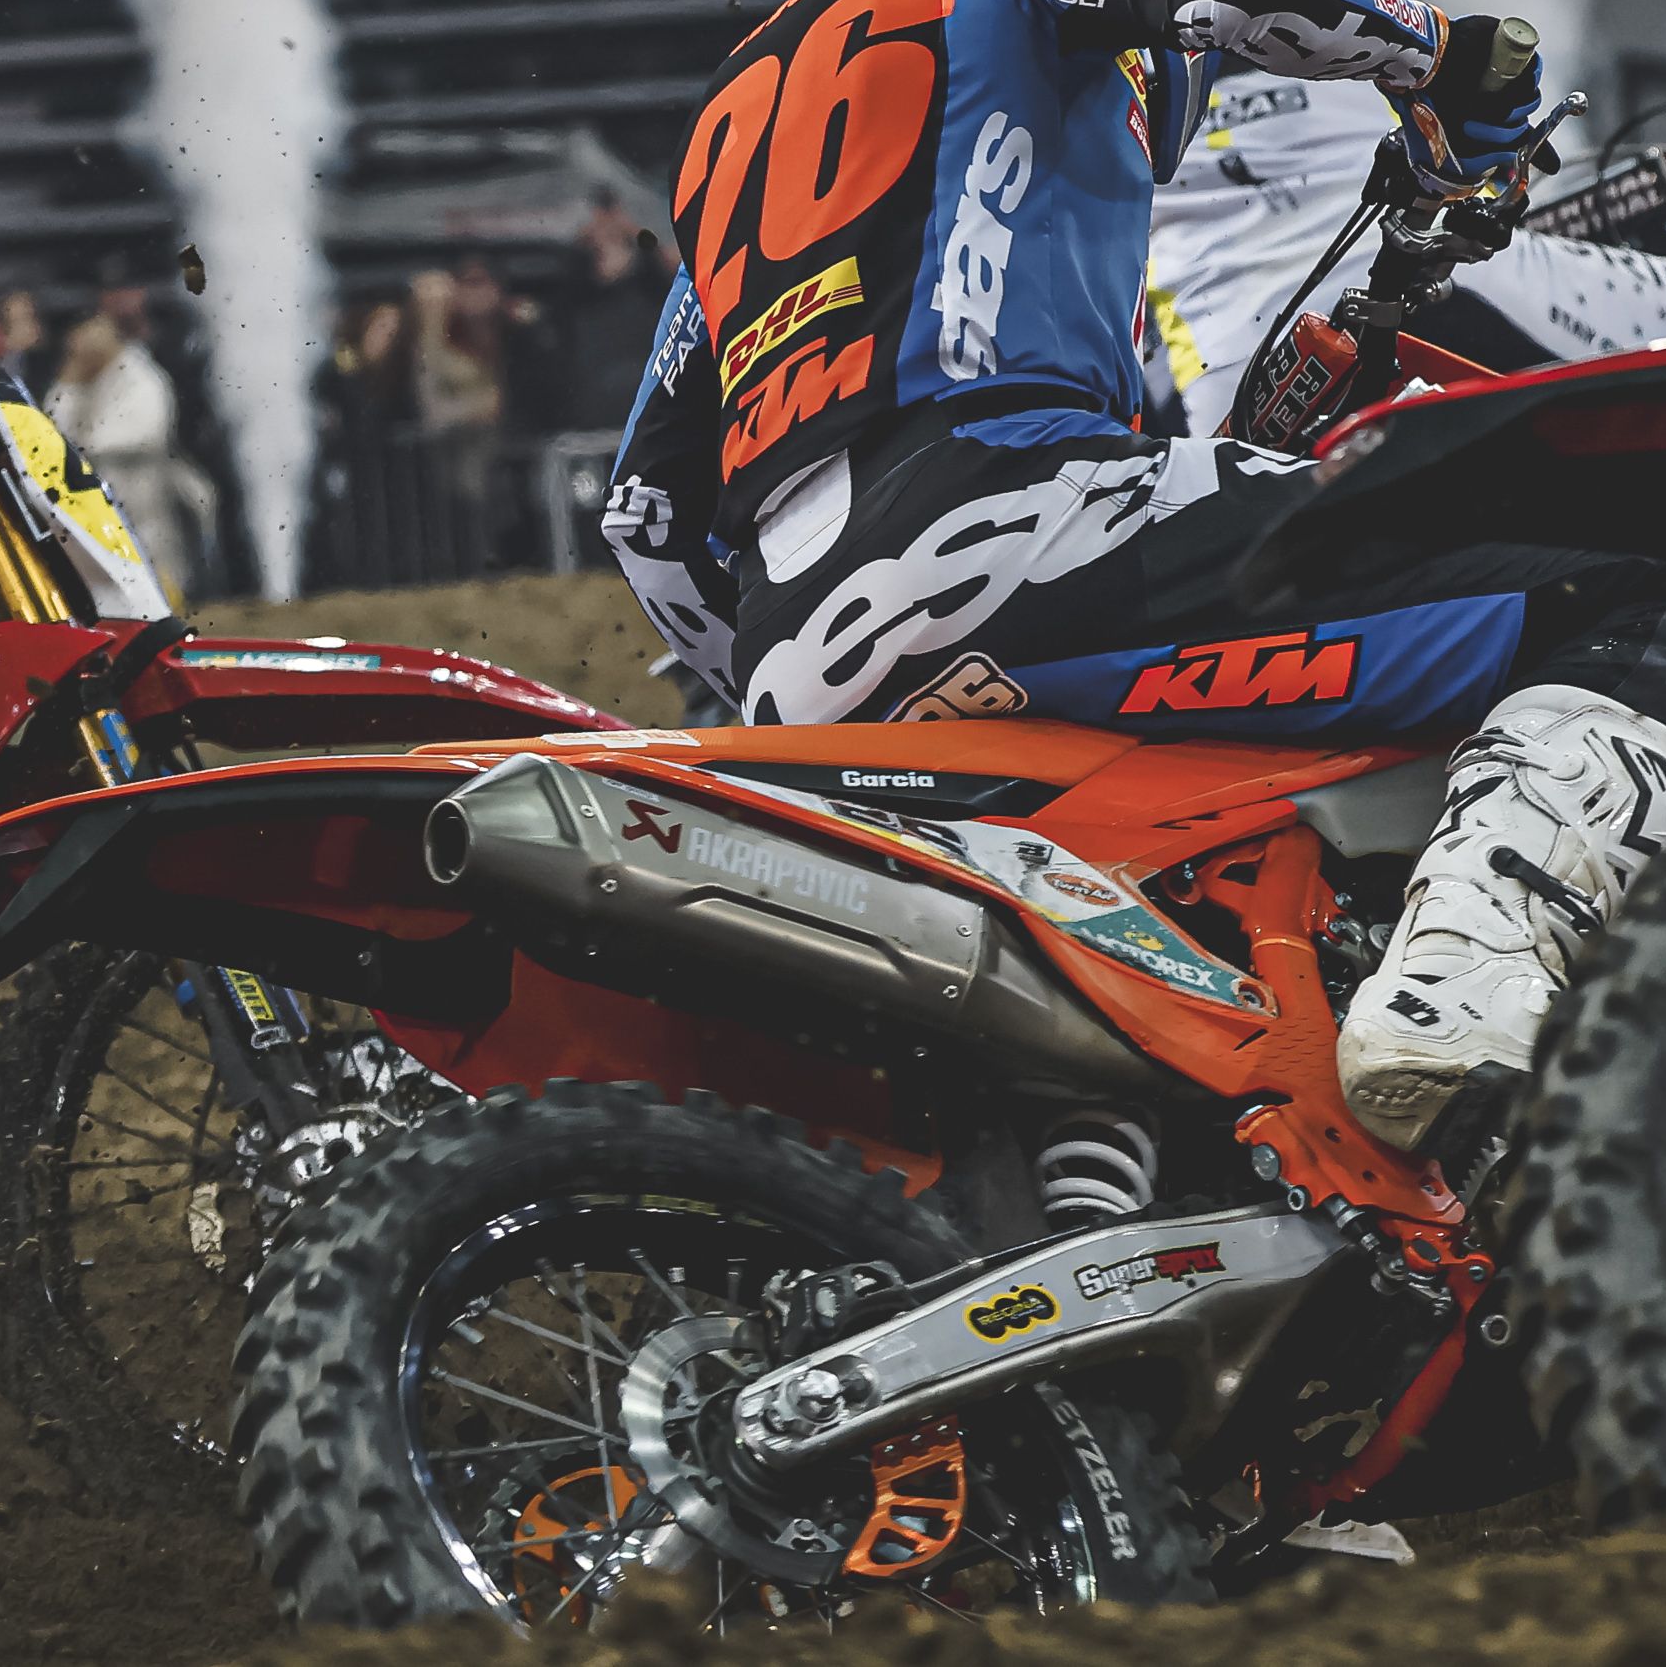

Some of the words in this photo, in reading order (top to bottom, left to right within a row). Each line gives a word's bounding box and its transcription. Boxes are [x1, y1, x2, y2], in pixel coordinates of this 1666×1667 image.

[725, 278, 833, 386] DHL
[721, 333, 875, 486] KTM
[1118, 632, 1357, 714] KTM
